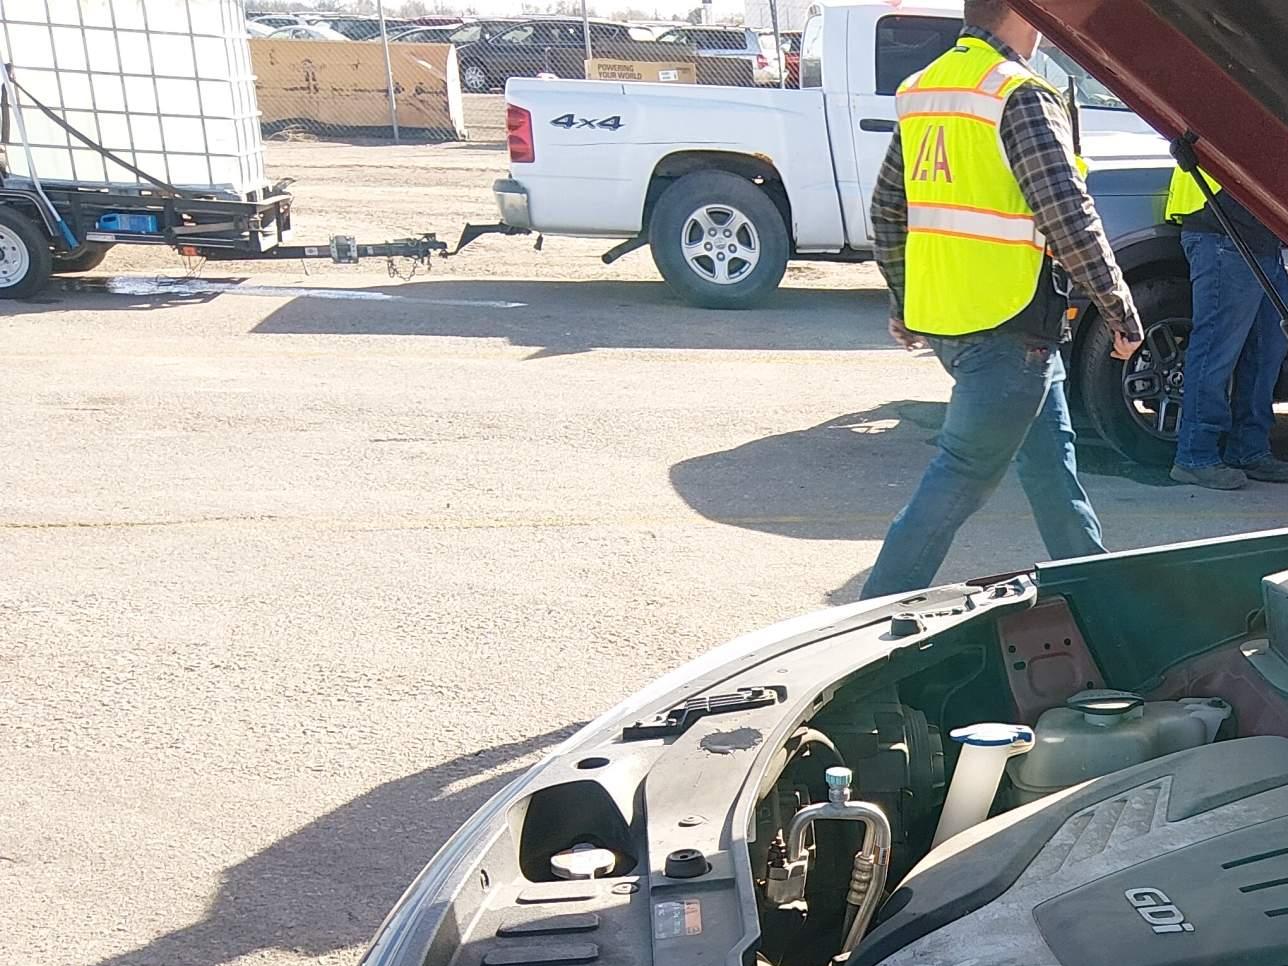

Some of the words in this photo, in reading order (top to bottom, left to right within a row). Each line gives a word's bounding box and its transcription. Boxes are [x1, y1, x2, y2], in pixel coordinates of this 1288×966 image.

[597, 64, 634, 72] POWERING
[599, 71, 617, 79] YOUR
[619, 72, 642, 80] WORLD
[550, 113, 625, 131] 4x4
